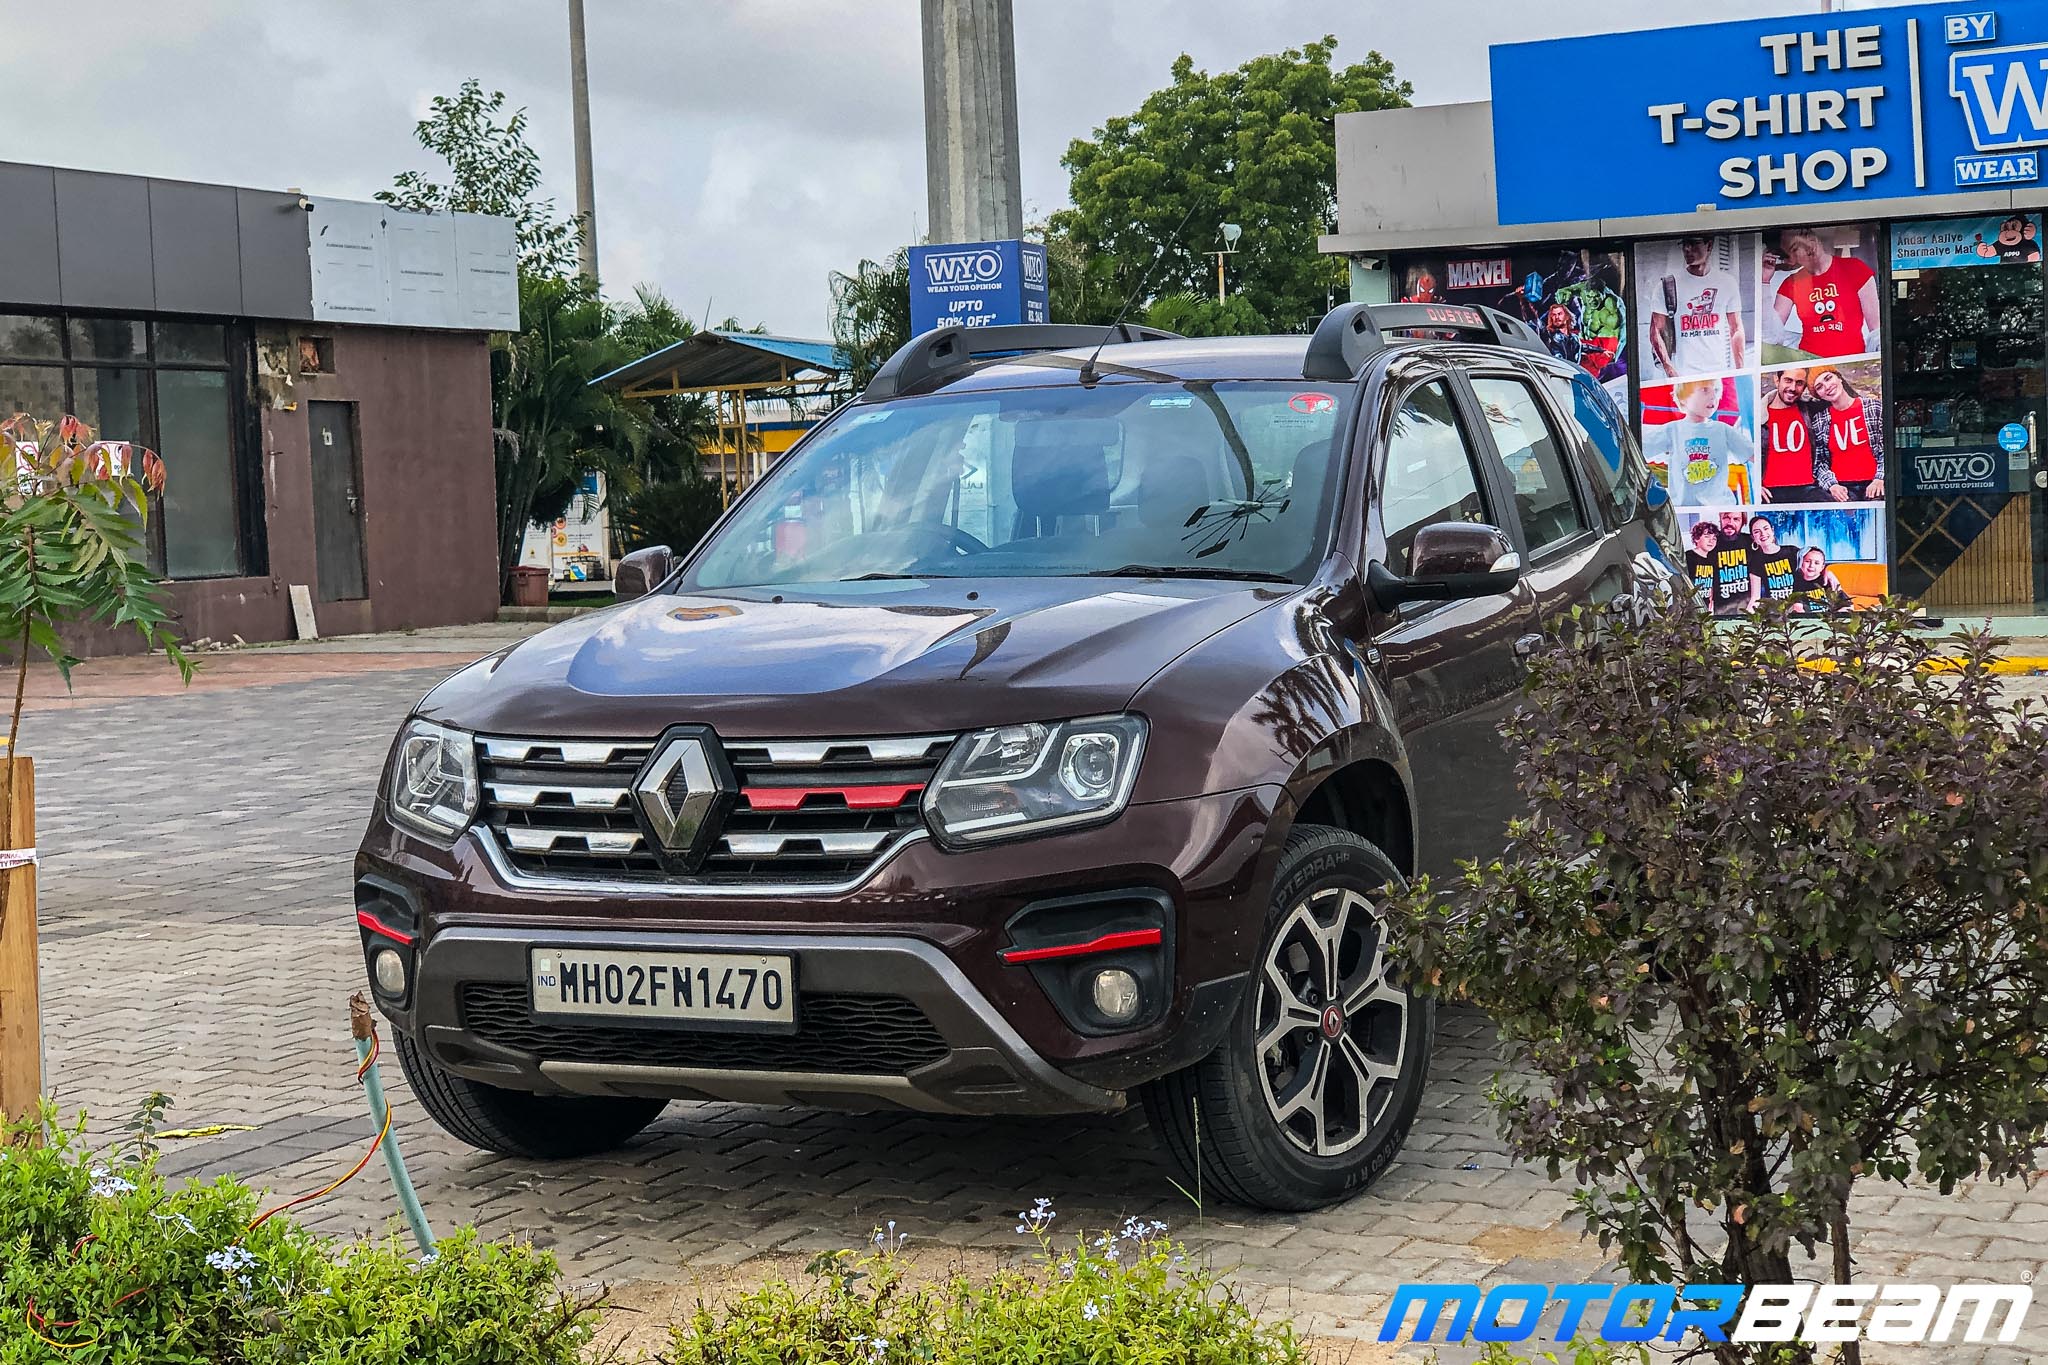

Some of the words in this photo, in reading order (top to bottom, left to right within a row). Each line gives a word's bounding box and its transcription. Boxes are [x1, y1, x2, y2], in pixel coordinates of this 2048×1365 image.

[1947, 14, 1991, 41] BY
[1759, 25, 1882, 75] THE
[1648, 85, 1884, 144] T-SHIRT
[1719, 147, 1888, 198] SHOP
[1957, 157, 2035, 180] WEAR
[1897, 233, 1928, 246] Andar
[1954, 243, 1974, 255] Mat
[929, 255, 997, 281] WYO
[1023, 255, 1043, 279] WYO
[1448, 260, 1510, 287] MARVEL
[927, 285, 949, 293] WEAR
[949, 284, 970, 292] YOUR
[970, 282, 1002, 291] OPINION
[948, 299, 983, 313] UPTO
[936, 315, 964, 328] 50%
[1426, 308, 1484, 325] DUSTER
[1680, 314, 1719, 331] BAAP
[1772, 419, 1806, 454] LO
[1833, 416, 1867, 451] VE
[1918, 456, 1990, 480] WYO
[1939, 482, 1961, 490] YOUR
[1961, 481, 1995, 489] OPINION
[1718, 548, 1747, 569] HUM
[1764, 558, 1793, 576] HUM
[1695, 564, 1714, 578] HUM
[1719, 564, 1748, 584] NAHI
[537, 975, 557, 988] IND
[559, 962, 783, 1011] MH02FN1470
